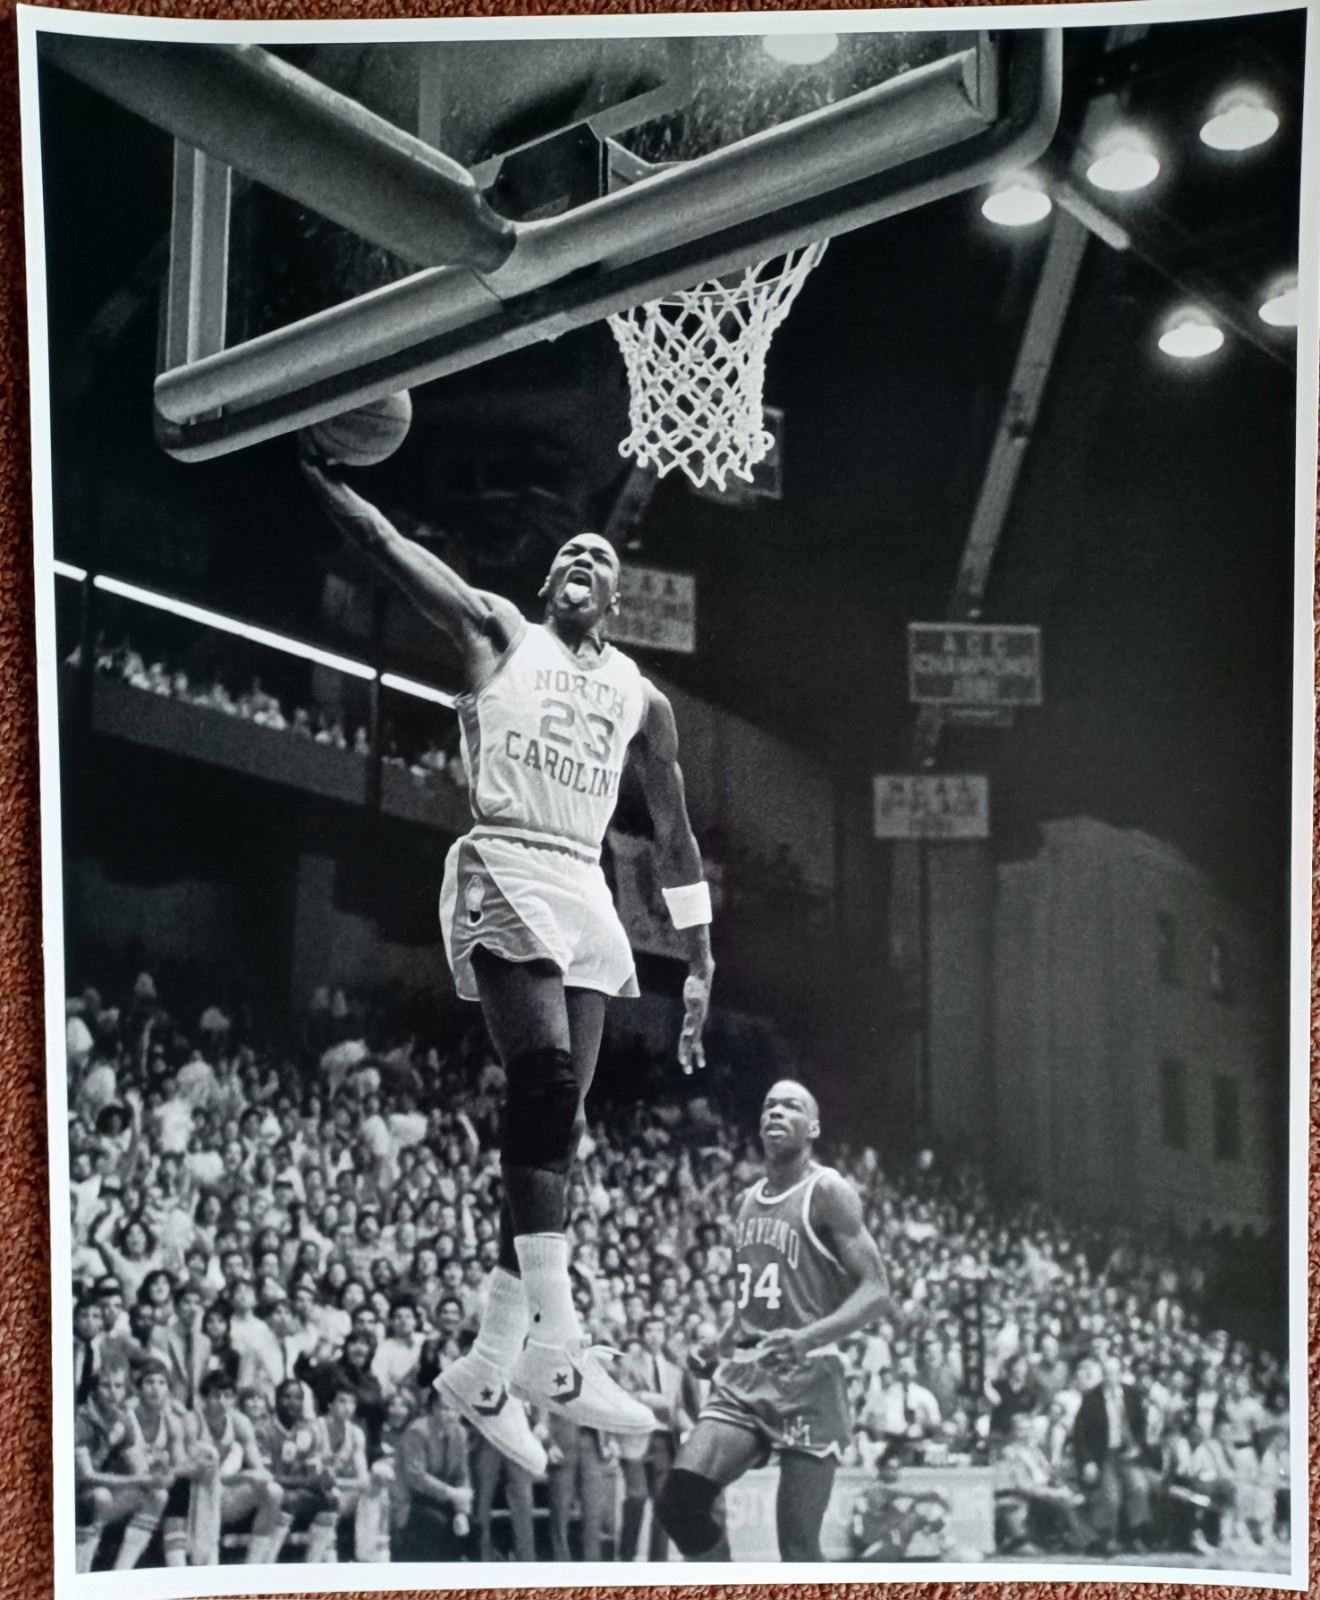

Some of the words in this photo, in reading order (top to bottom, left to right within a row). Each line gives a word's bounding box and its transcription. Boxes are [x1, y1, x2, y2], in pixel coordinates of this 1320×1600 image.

[534, 669, 628, 719] NORTH
[539, 697, 615, 765] 23
[736, 1262, 782, 1309] 34
